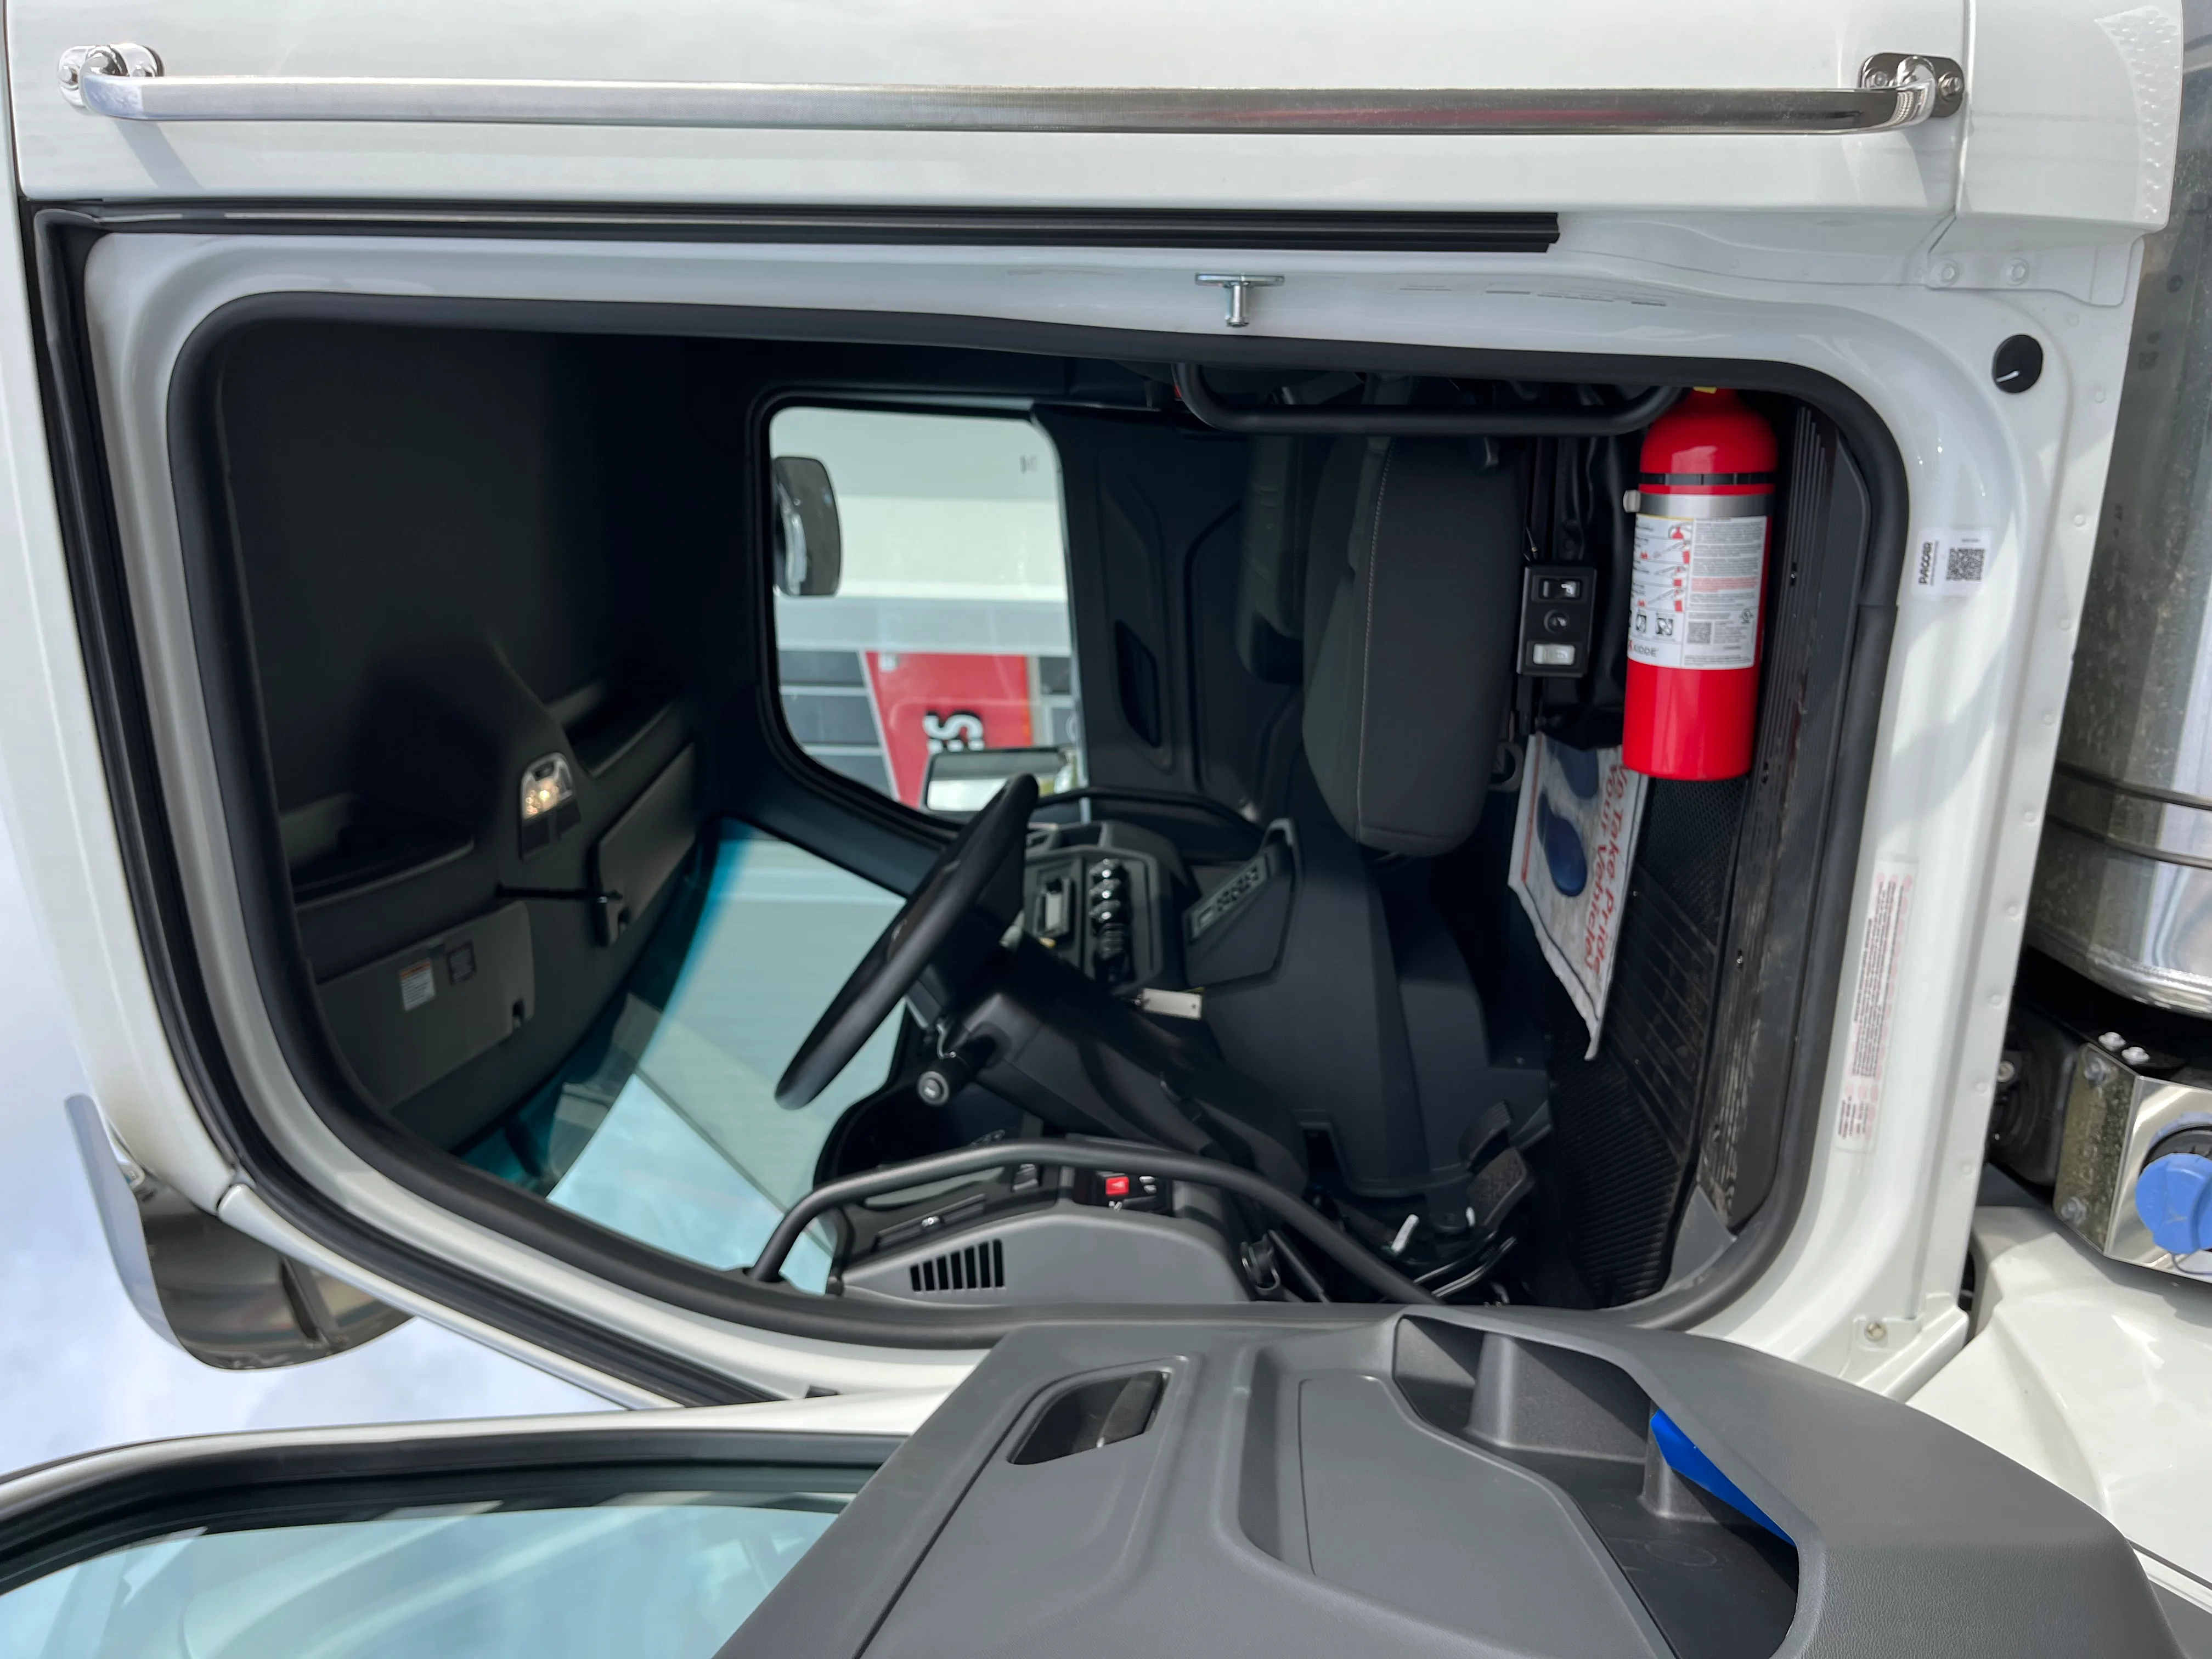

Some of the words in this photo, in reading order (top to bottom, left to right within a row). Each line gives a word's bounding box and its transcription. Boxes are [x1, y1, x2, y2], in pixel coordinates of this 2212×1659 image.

[1917, 541, 1932, 585] PACCAR
[1607, 810, 1622, 879] Take
[1594, 889, 1614, 975] Pride
